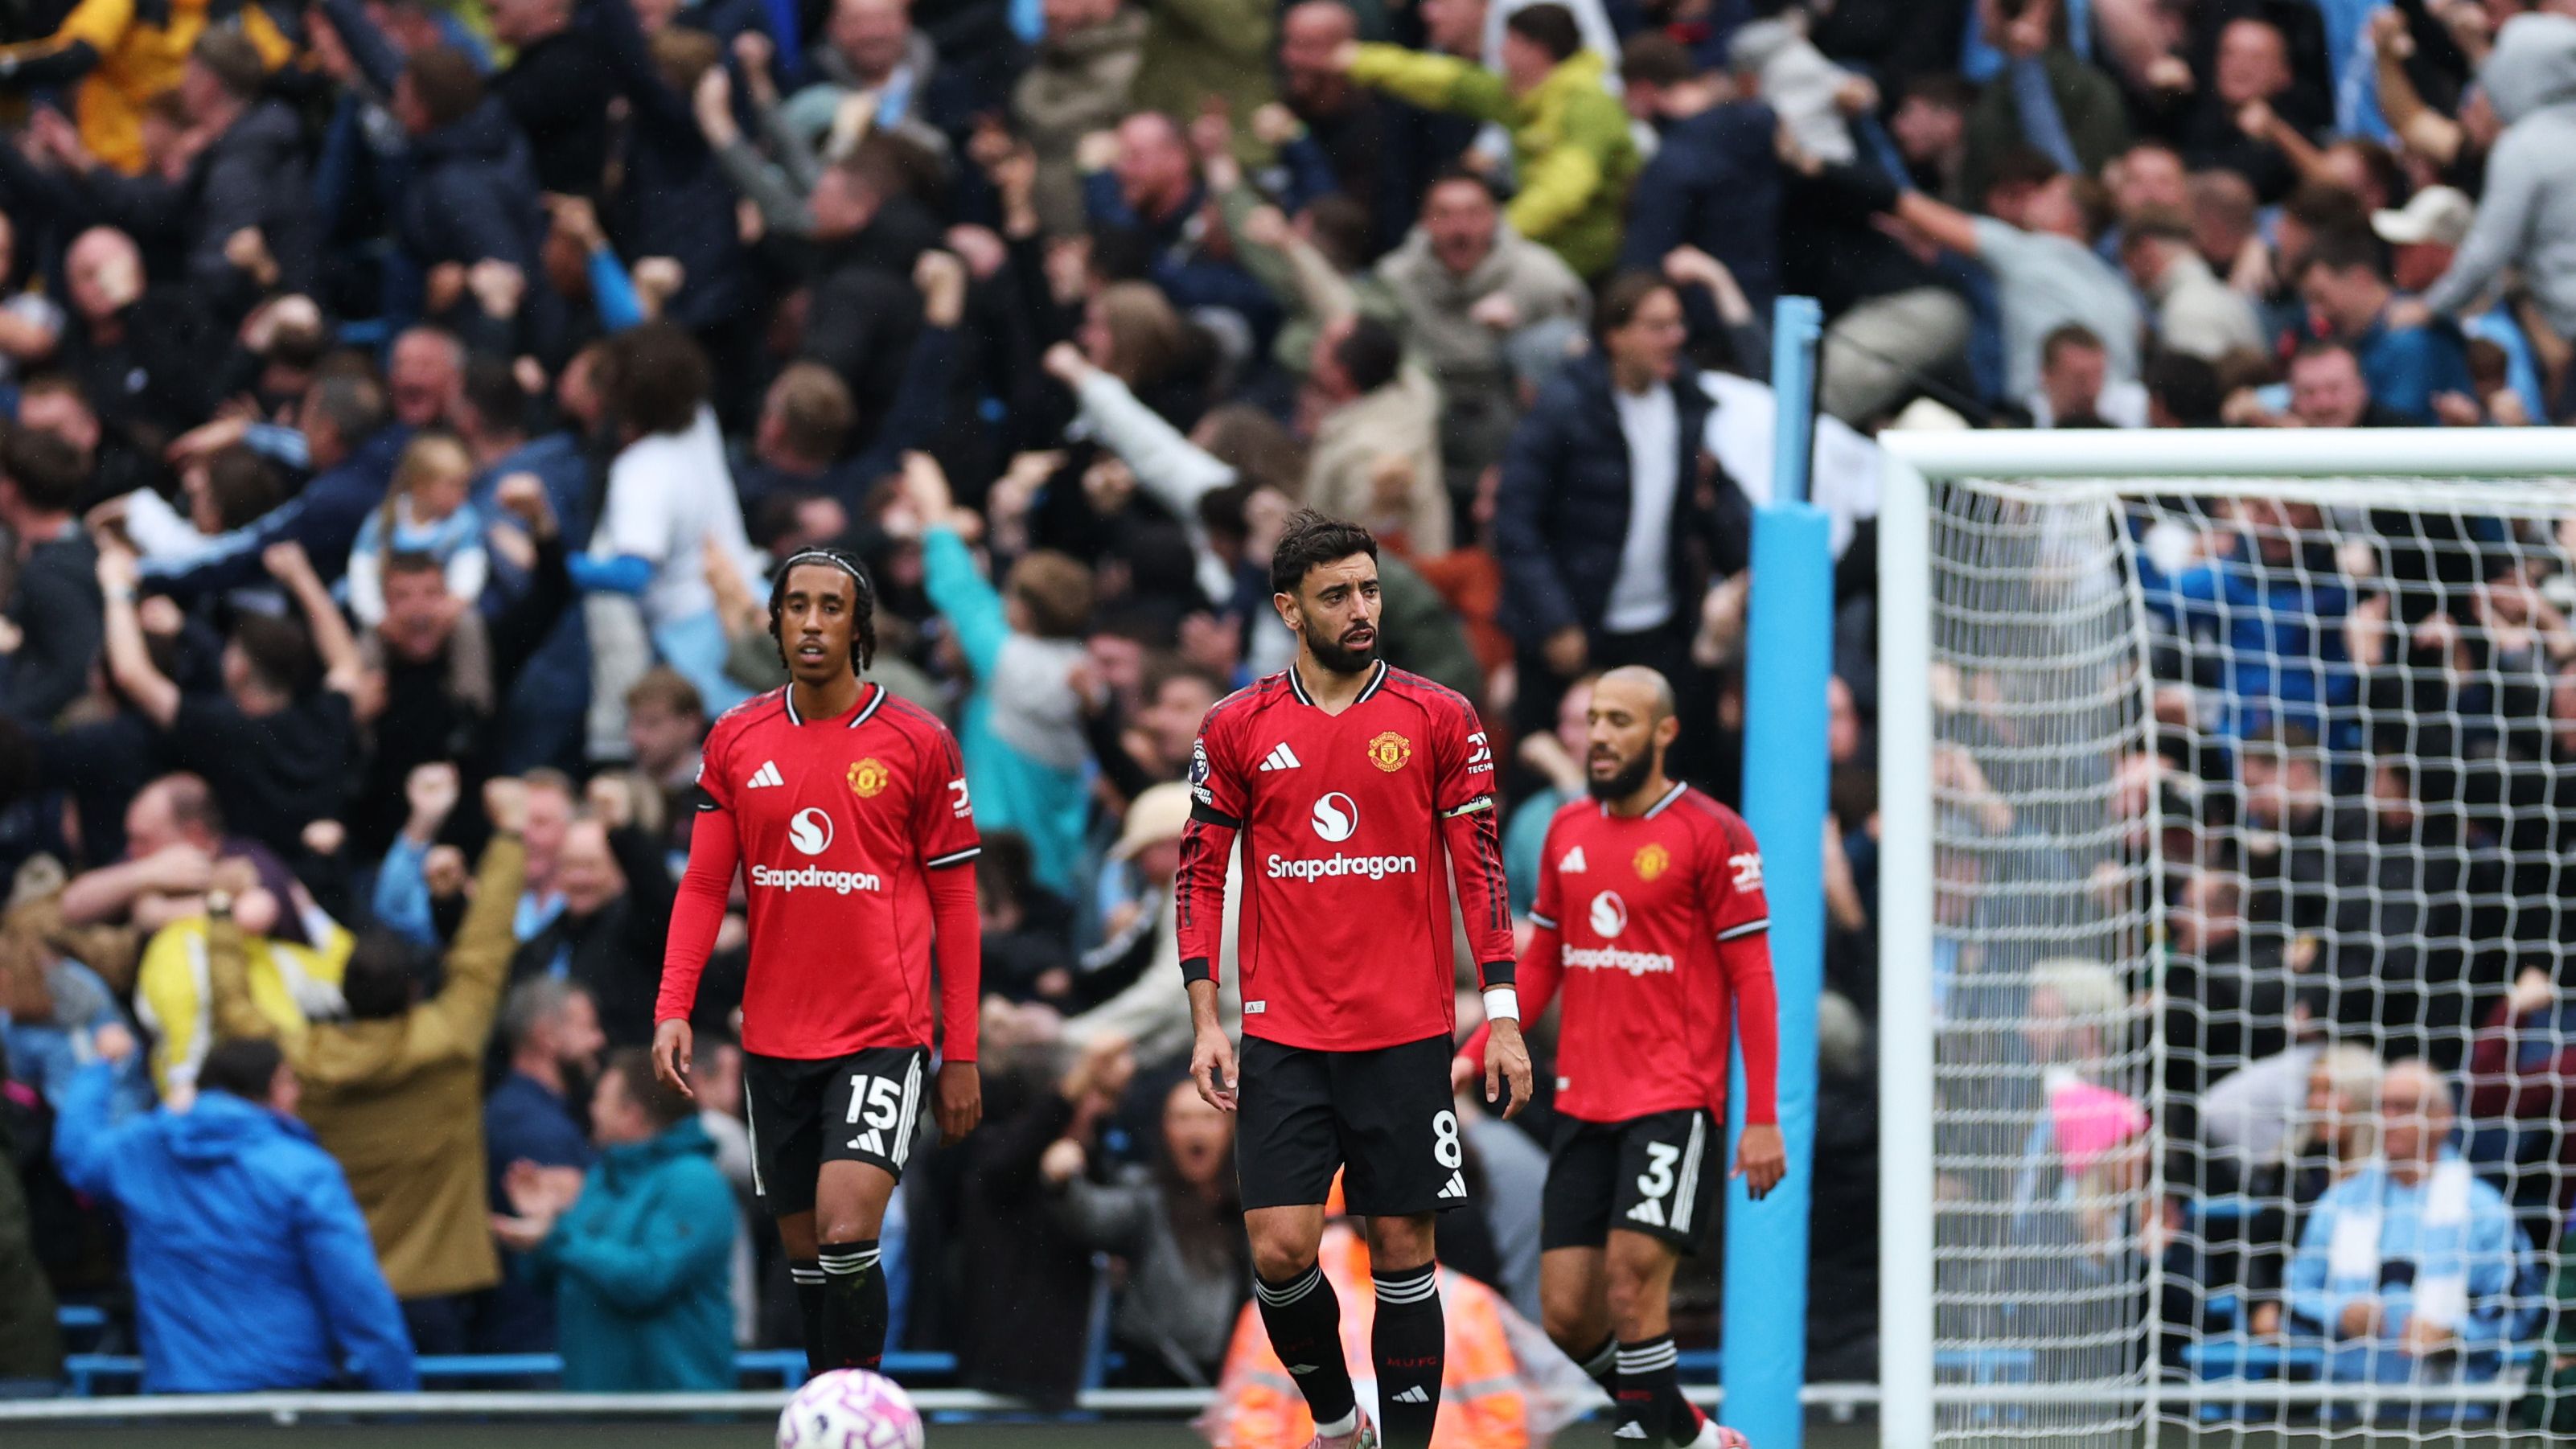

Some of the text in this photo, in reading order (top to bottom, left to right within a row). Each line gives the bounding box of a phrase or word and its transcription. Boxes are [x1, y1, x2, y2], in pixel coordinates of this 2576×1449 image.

[1267, 852, 1415, 883] Snapdragon
[846, 1074, 902, 1131] 15
[1432, 1110, 1462, 1168] 8
[1637, 1140, 1680, 1198] 3
